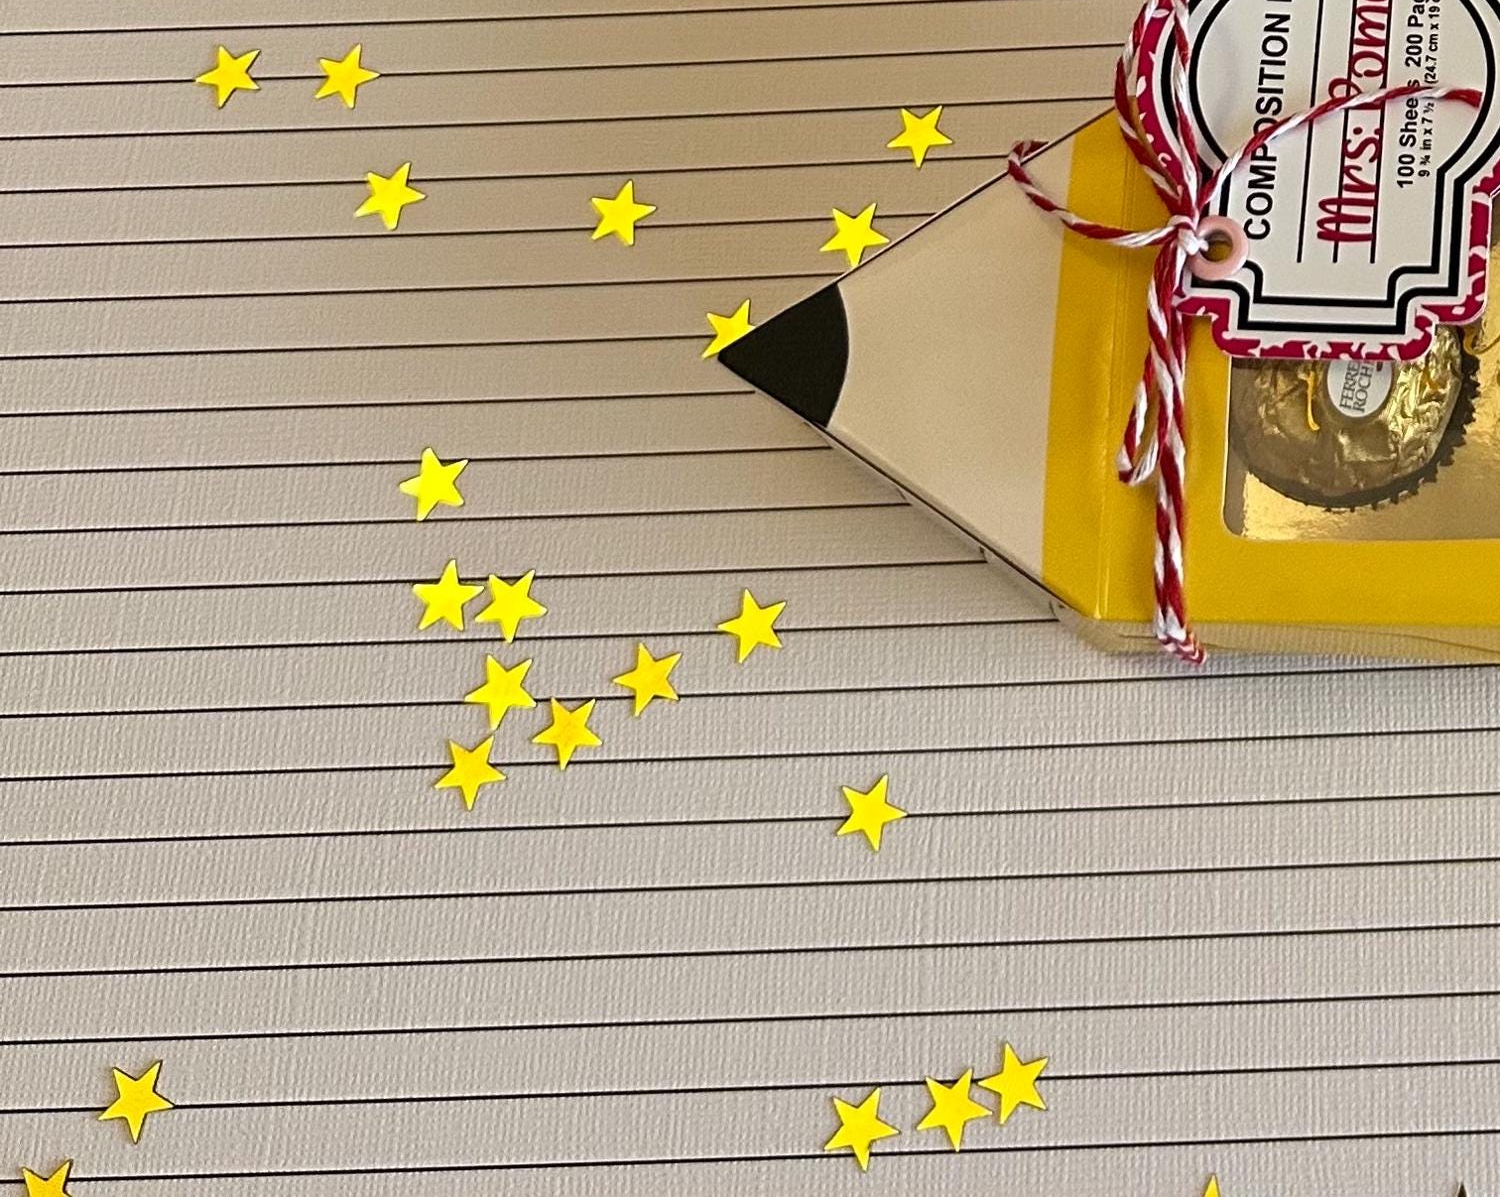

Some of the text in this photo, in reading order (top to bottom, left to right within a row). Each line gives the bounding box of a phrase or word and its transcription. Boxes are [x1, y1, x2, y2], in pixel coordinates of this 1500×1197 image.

[1428, 5, 1440, 19] 19
[1430, 22, 1439, 30] x
[1404, 33, 1423, 68] 200
[1428, 33, 1438, 52] cm
[1423, 54, 1439, 84] (24.7
[1399, 79, 1421, 147] Shees
[1423, 127, 1433, 136] x
[1420, 138, 1432, 150] in
[1396, 154, 1416, 188] 100
[1418, 169, 1430, 177] 9
[1339, 361, 1361, 409] FERRE
[1352, 360, 1375, 413] ROCH
